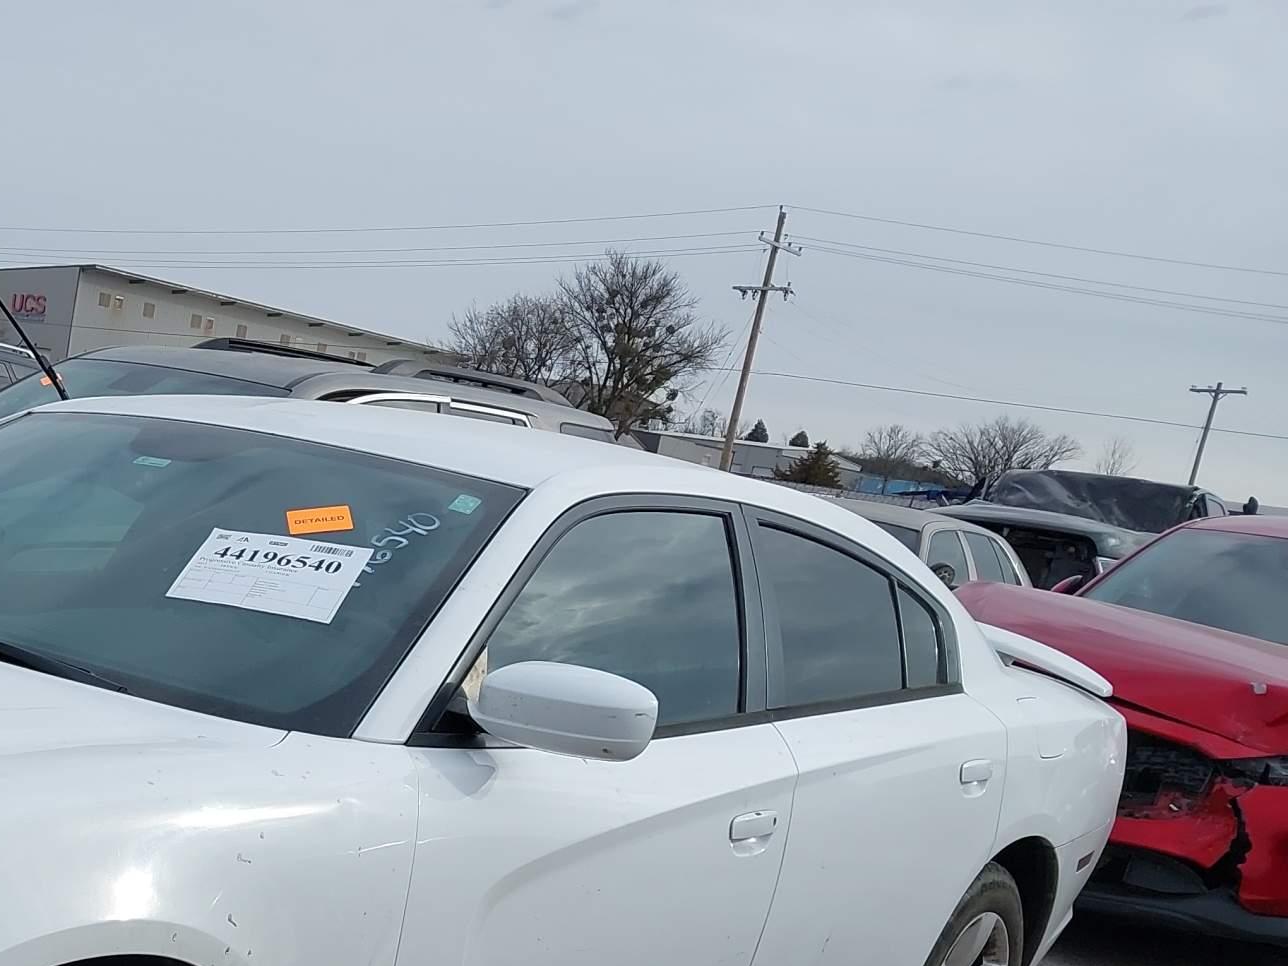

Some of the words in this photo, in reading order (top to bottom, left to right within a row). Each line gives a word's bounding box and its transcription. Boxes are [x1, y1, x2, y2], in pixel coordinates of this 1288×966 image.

[11, 293, 47, 313] UCS
[294, 515, 345, 525] DETAILED
[213, 546, 343, 574] 44196540
